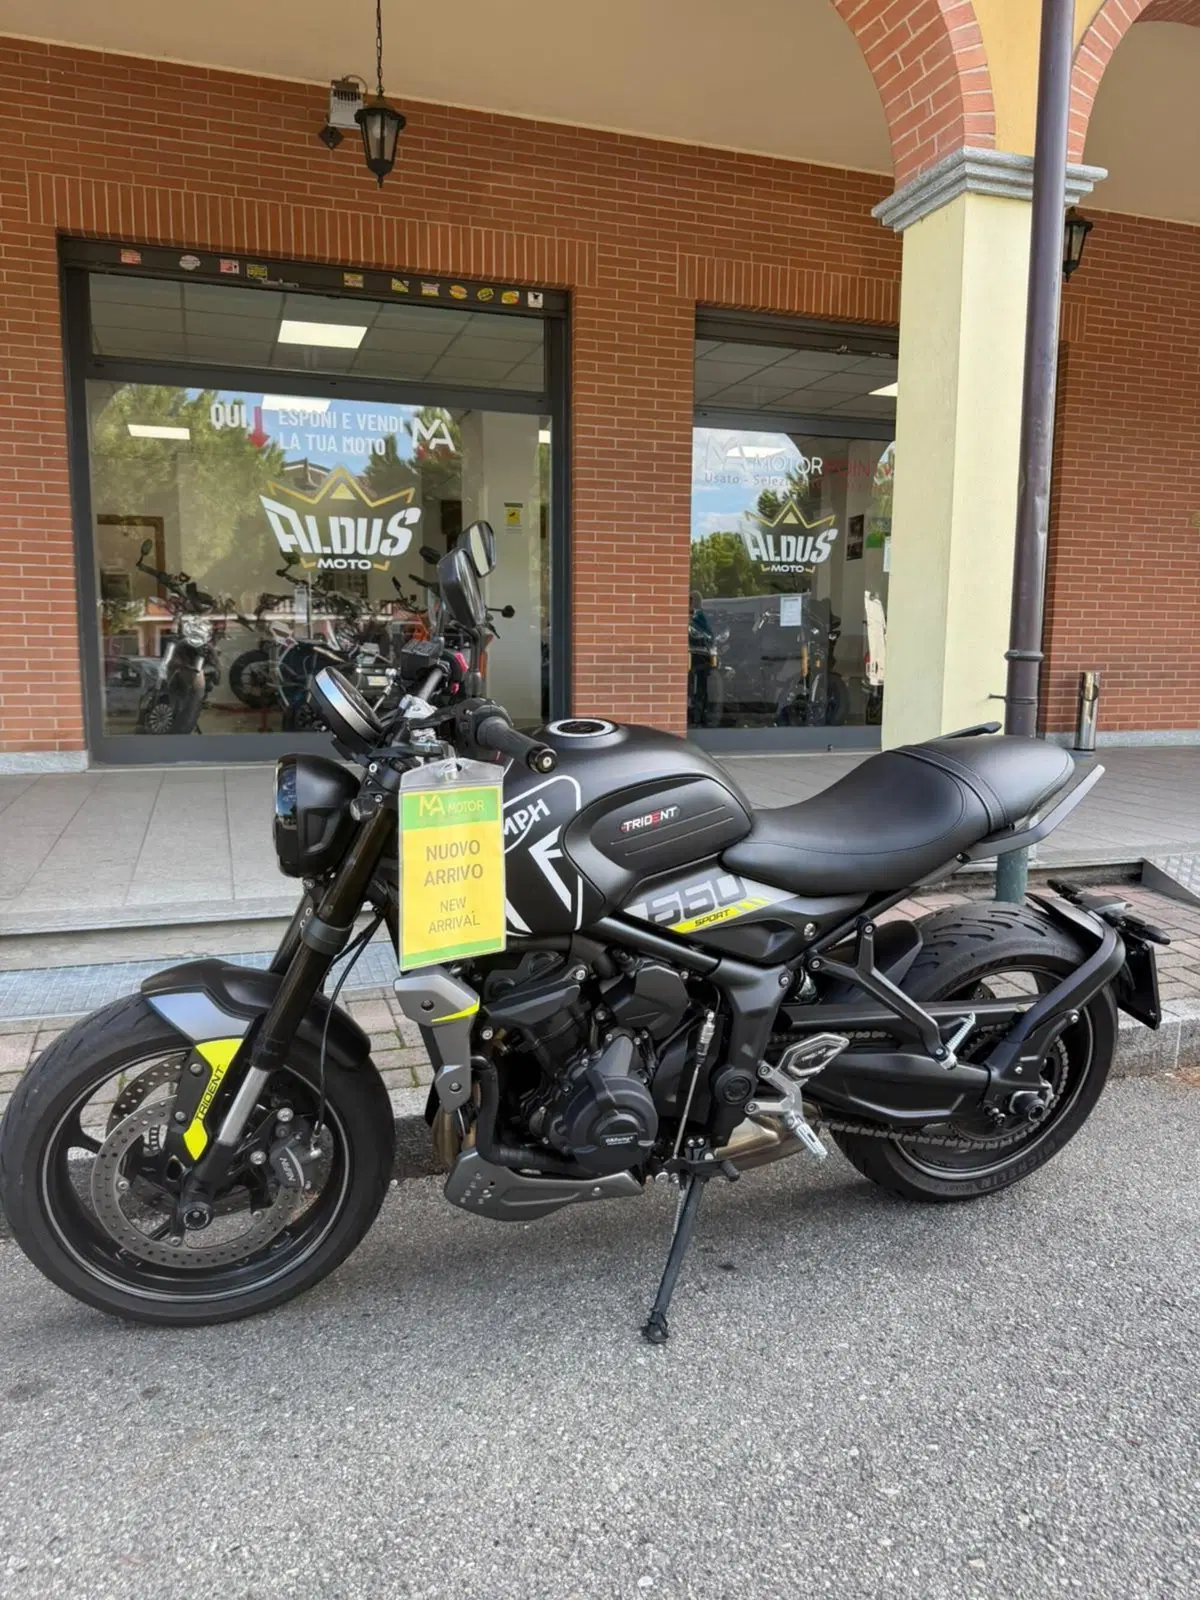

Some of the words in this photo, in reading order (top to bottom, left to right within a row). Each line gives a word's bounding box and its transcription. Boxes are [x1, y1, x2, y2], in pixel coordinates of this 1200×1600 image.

[279, 408, 338, 429] ESPONI
[343, 412, 352, 430] E
[356, 413, 404, 433] VENDI
[279, 431, 300, 450] LA
[304, 434, 338, 452] TUA
[343, 437, 386, 455] MOTO
[704, 471, 740, 484] Usato
[259, 494, 421, 557] ALDUS
[740, 520, 838, 563] ALDUS
[317, 558, 372, 570] MOTO
[770, 564, 805, 573] MOTO
[448, 799, 485, 814] MOTOR
[623, 806, 678, 832] TRIDENT
[425, 839, 481, 862] NUOVO
[424, 863, 483, 887] ARRIVO
[439, 896, 466, 913] NEW
[428, 913, 481, 935] ARRIVAL
[694, 908, 731, 927] SPORT
[195, 1064, 224, 1121] TRIDENT
